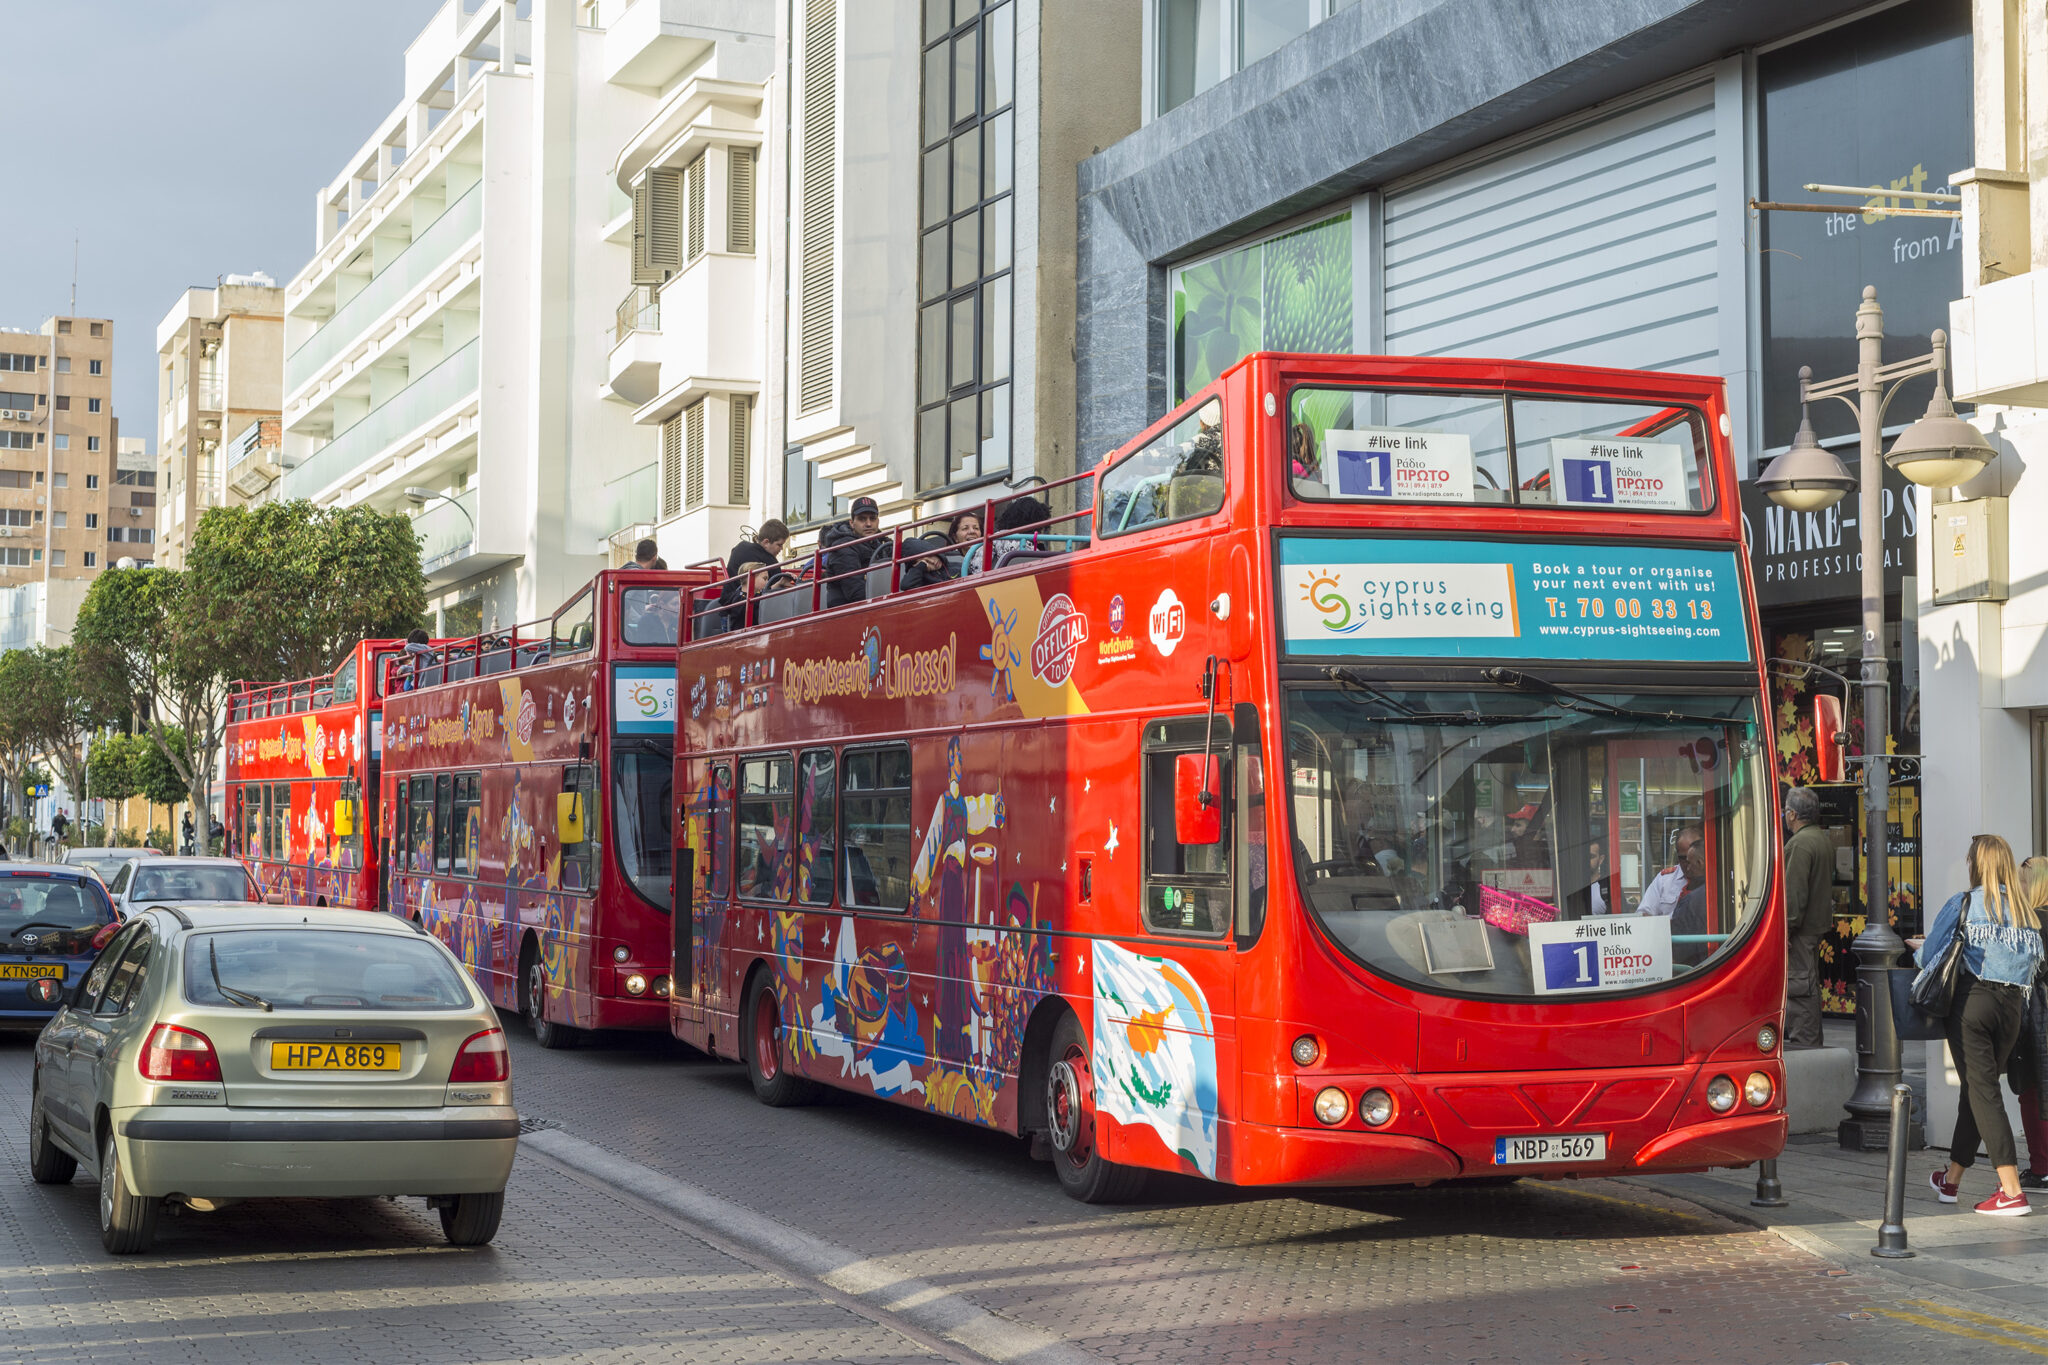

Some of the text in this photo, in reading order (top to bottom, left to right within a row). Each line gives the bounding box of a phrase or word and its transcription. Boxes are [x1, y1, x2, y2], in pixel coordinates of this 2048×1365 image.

[1826, 213, 1856, 237] the
[1862, 163, 1928, 225] art
[1893, 235, 1940, 264] from
[1368, 435, 1428, 450] #live link
[1590, 445, 1644, 459] #live link
[1396, 458, 1426, 469] Ράδιο
[1616, 467, 1642, 477] Ράδιο
[1365, 456, 1385, 491] 1
[1396, 469, 1450, 482] ΠΡΩΤΟ
[1588, 465, 1607, 499] 1
[1616, 477, 1664, 491] ΠΡΩΤΟ
[1533, 563, 1713, 579] Book a tour or organise
[1766, 547, 1903, 583] PROFESSIOAL
[1363, 580, 1447, 599] cyprus
[1533, 579, 1716, 592] your next event with us!
[1359, 598, 1504, 620] sightseeing
[1545, 597, 1713, 620] T: 70 00 33 13
[1539, 624, 1721, 639] www.cyprus-sightseeing.com
[1036, 617, 1086, 669] OFFICIAL
[885, 631, 957, 699] Limassol
[1051, 652, 1073, 680] TOUR
[1575, 923, 1632, 938] #live link
[1603, 944, 1631, 956] Ράδιο
[1573, 946, 1593, 983] 1
[1603, 954, 1653, 969] ΠΡΩΤΟ
[2, 966, 57, 978] KTN904
[287, 1046, 386, 1067] HPA869
[1513, 1137, 1595, 1160] NBP 569
